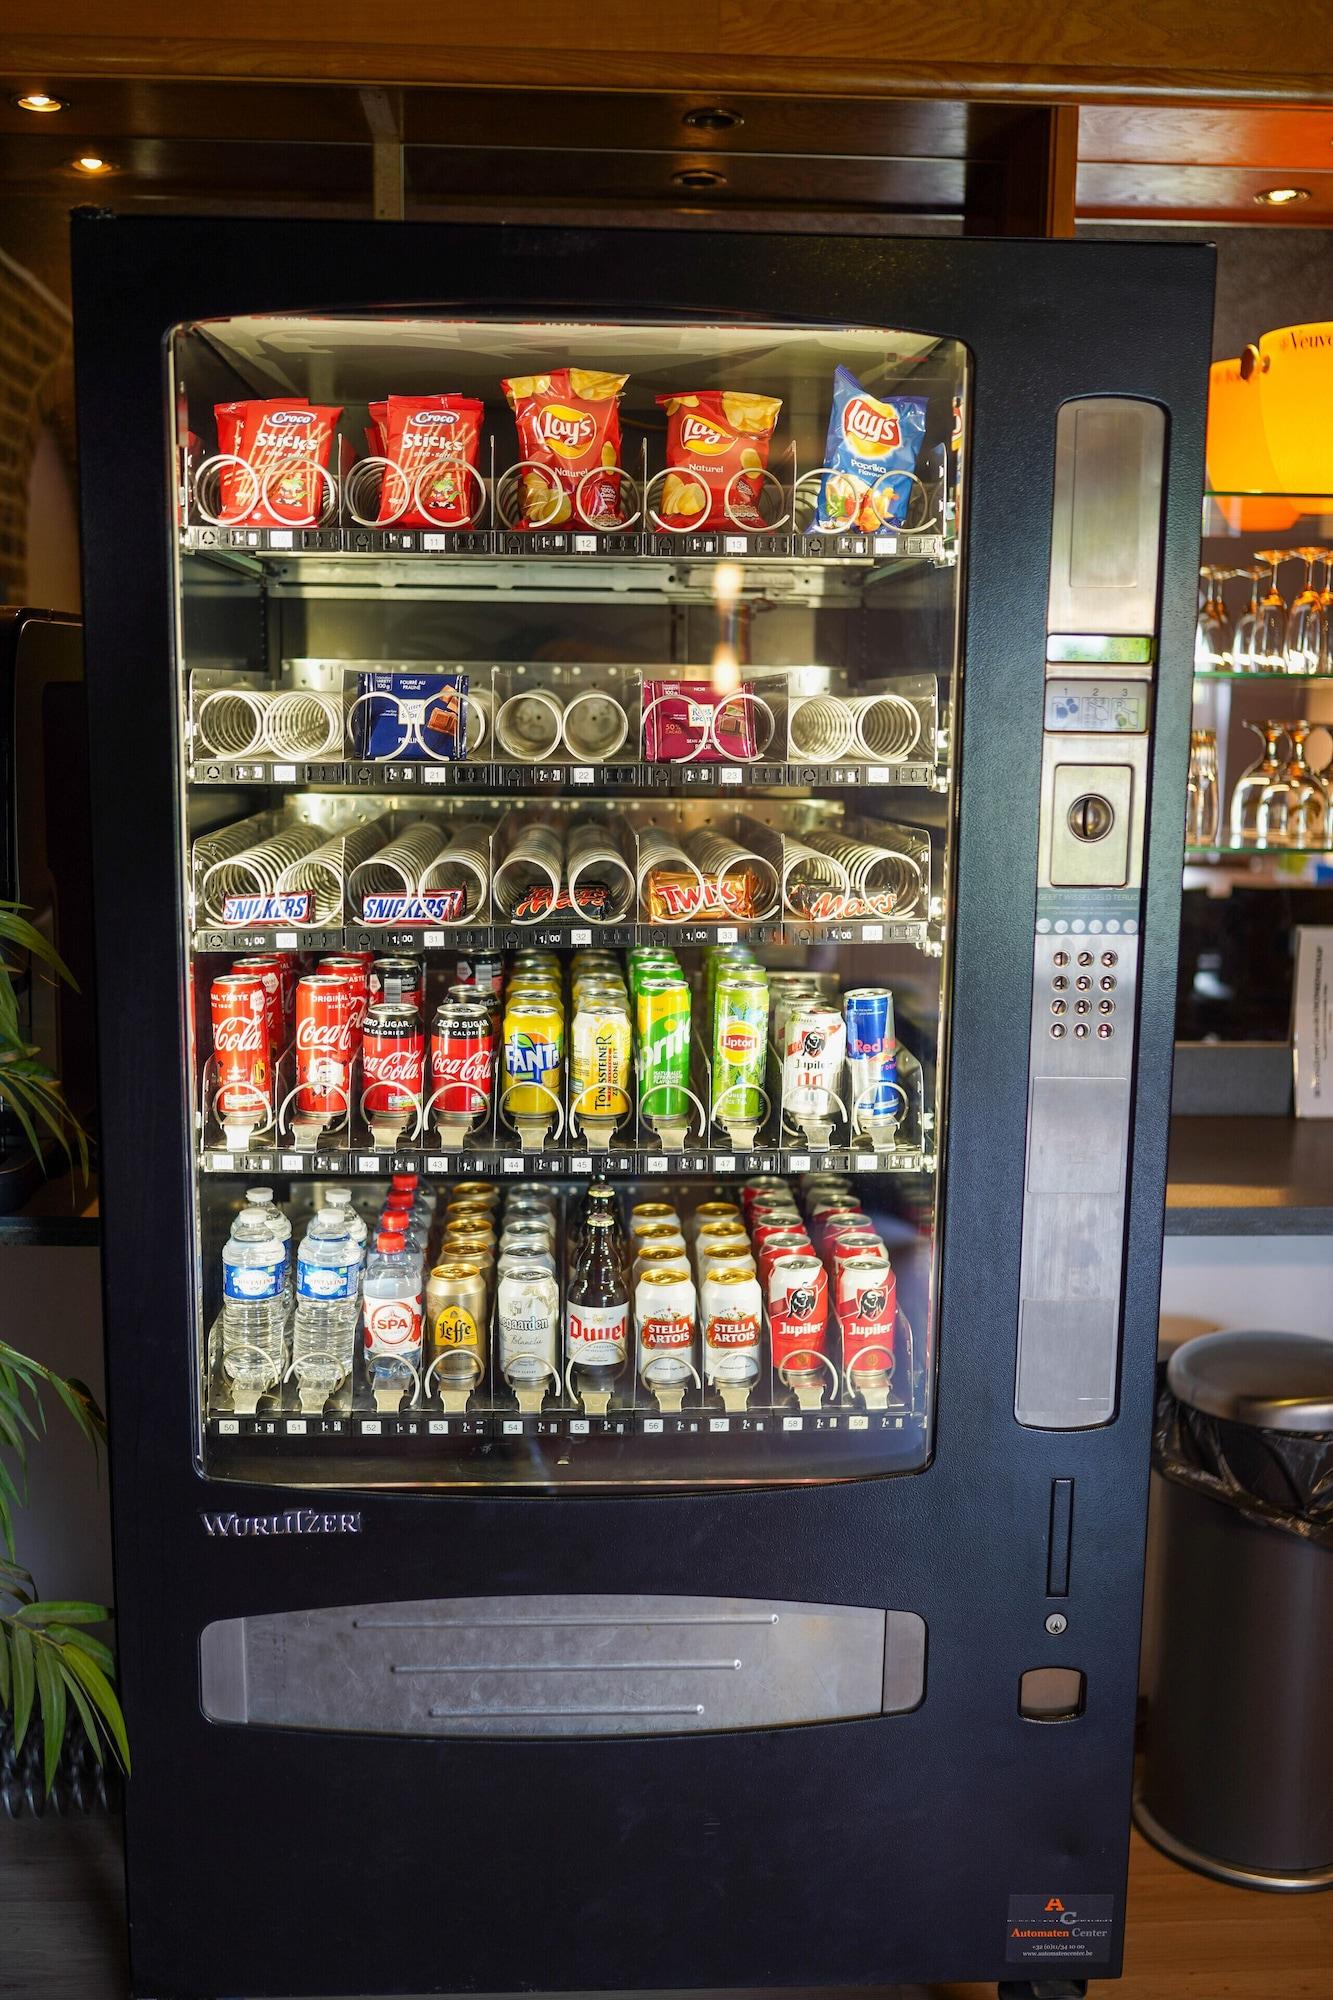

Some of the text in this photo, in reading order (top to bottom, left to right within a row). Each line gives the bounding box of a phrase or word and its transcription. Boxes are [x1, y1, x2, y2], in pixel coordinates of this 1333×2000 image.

[271, 412, 311, 424] Croco
[415, 412, 455, 423] Croco
[847, 400, 896, 442] Lay's
[544, 412, 592, 445] Lay's
[684, 418, 722, 444] Lay
[257, 432, 318, 451] Sticks
[402, 433, 464, 451] Sticks
[554, 467, 589, 478] Naturel
[688, 463, 724, 473] Naturel
[850, 458, 887, 474] Paprika
[1092, 688, 1100, 696] 2
[1122, 688, 1128, 697] 3
[429, 771, 440, 779] 21
[657, 881, 736, 915] TWIX
[364, 898, 447, 920] SNICKERS
[811, 892, 897, 920] Mars
[428, 935, 438, 943] 31
[575, 932, 586, 940] 32
[1057, 953, 1114, 968] 1 2 3
[1055, 977, 1112, 990] 4 5 6
[1055, 1001, 1110, 1015] 7 8 9
[438, 1019, 489, 1028] ZERO SUGAR
[371, 1028, 404, 1036] CALORIES
[640, 1017, 691, 1081] prit
[724, 1035, 755, 1050] Lipton
[856, 1038, 881, 1054] Red
[505, 1044, 560, 1072] FANTA
[378, 1319, 408, 1330] SPA
[500, 1316, 549, 1331] egaarden
[648, 1322, 689, 1334] STELLA
[713, 1321, 754, 1334] STELLA
[778, 1322, 824, 1338] Jupiler
[848, 1322, 893, 1338] Jupiler
[439, 1320, 472, 1343] Leffe
[648, 1332, 690, 1344] ARTOIS
[713, 1331, 755, 1343] ARTOIS
[714, 1421, 725, 1429] 57
[200, 1508, 359, 1537] WURLITZER
[1044, 1898, 1065, 1912] A
[1061, 1911, 1078, 1925] C
[1011, 1927, 1108, 1937] Automaten Center
